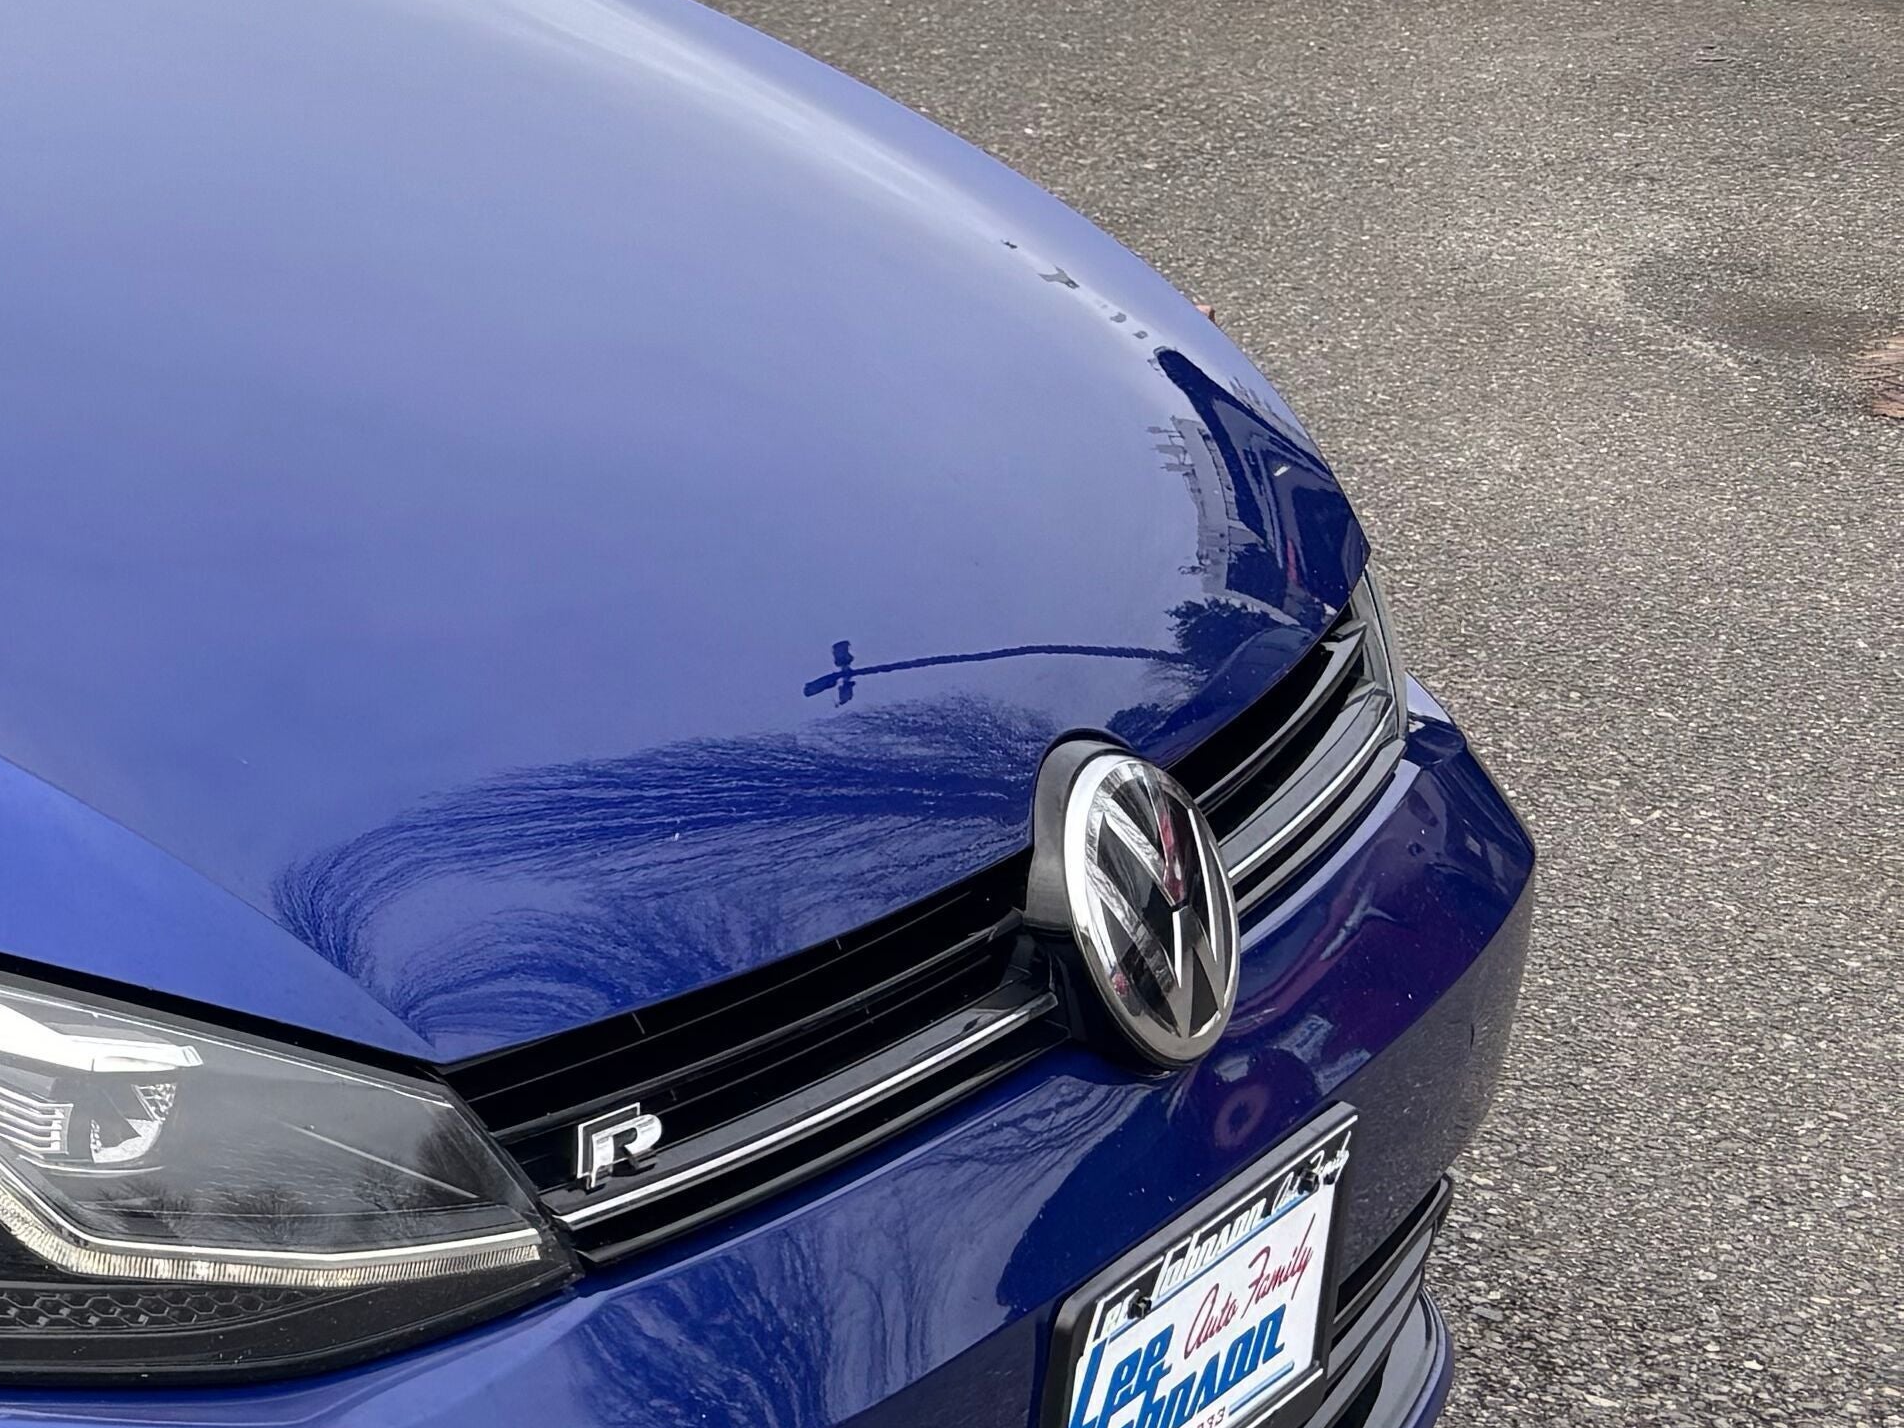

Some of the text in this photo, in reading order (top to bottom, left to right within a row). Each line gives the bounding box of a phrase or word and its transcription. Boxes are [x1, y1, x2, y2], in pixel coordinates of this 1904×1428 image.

[577, 1102, 662, 1189] R
[1151, 1197, 1268, 1301] Johnson
[1184, 1213, 1317, 1360] Auto Family
